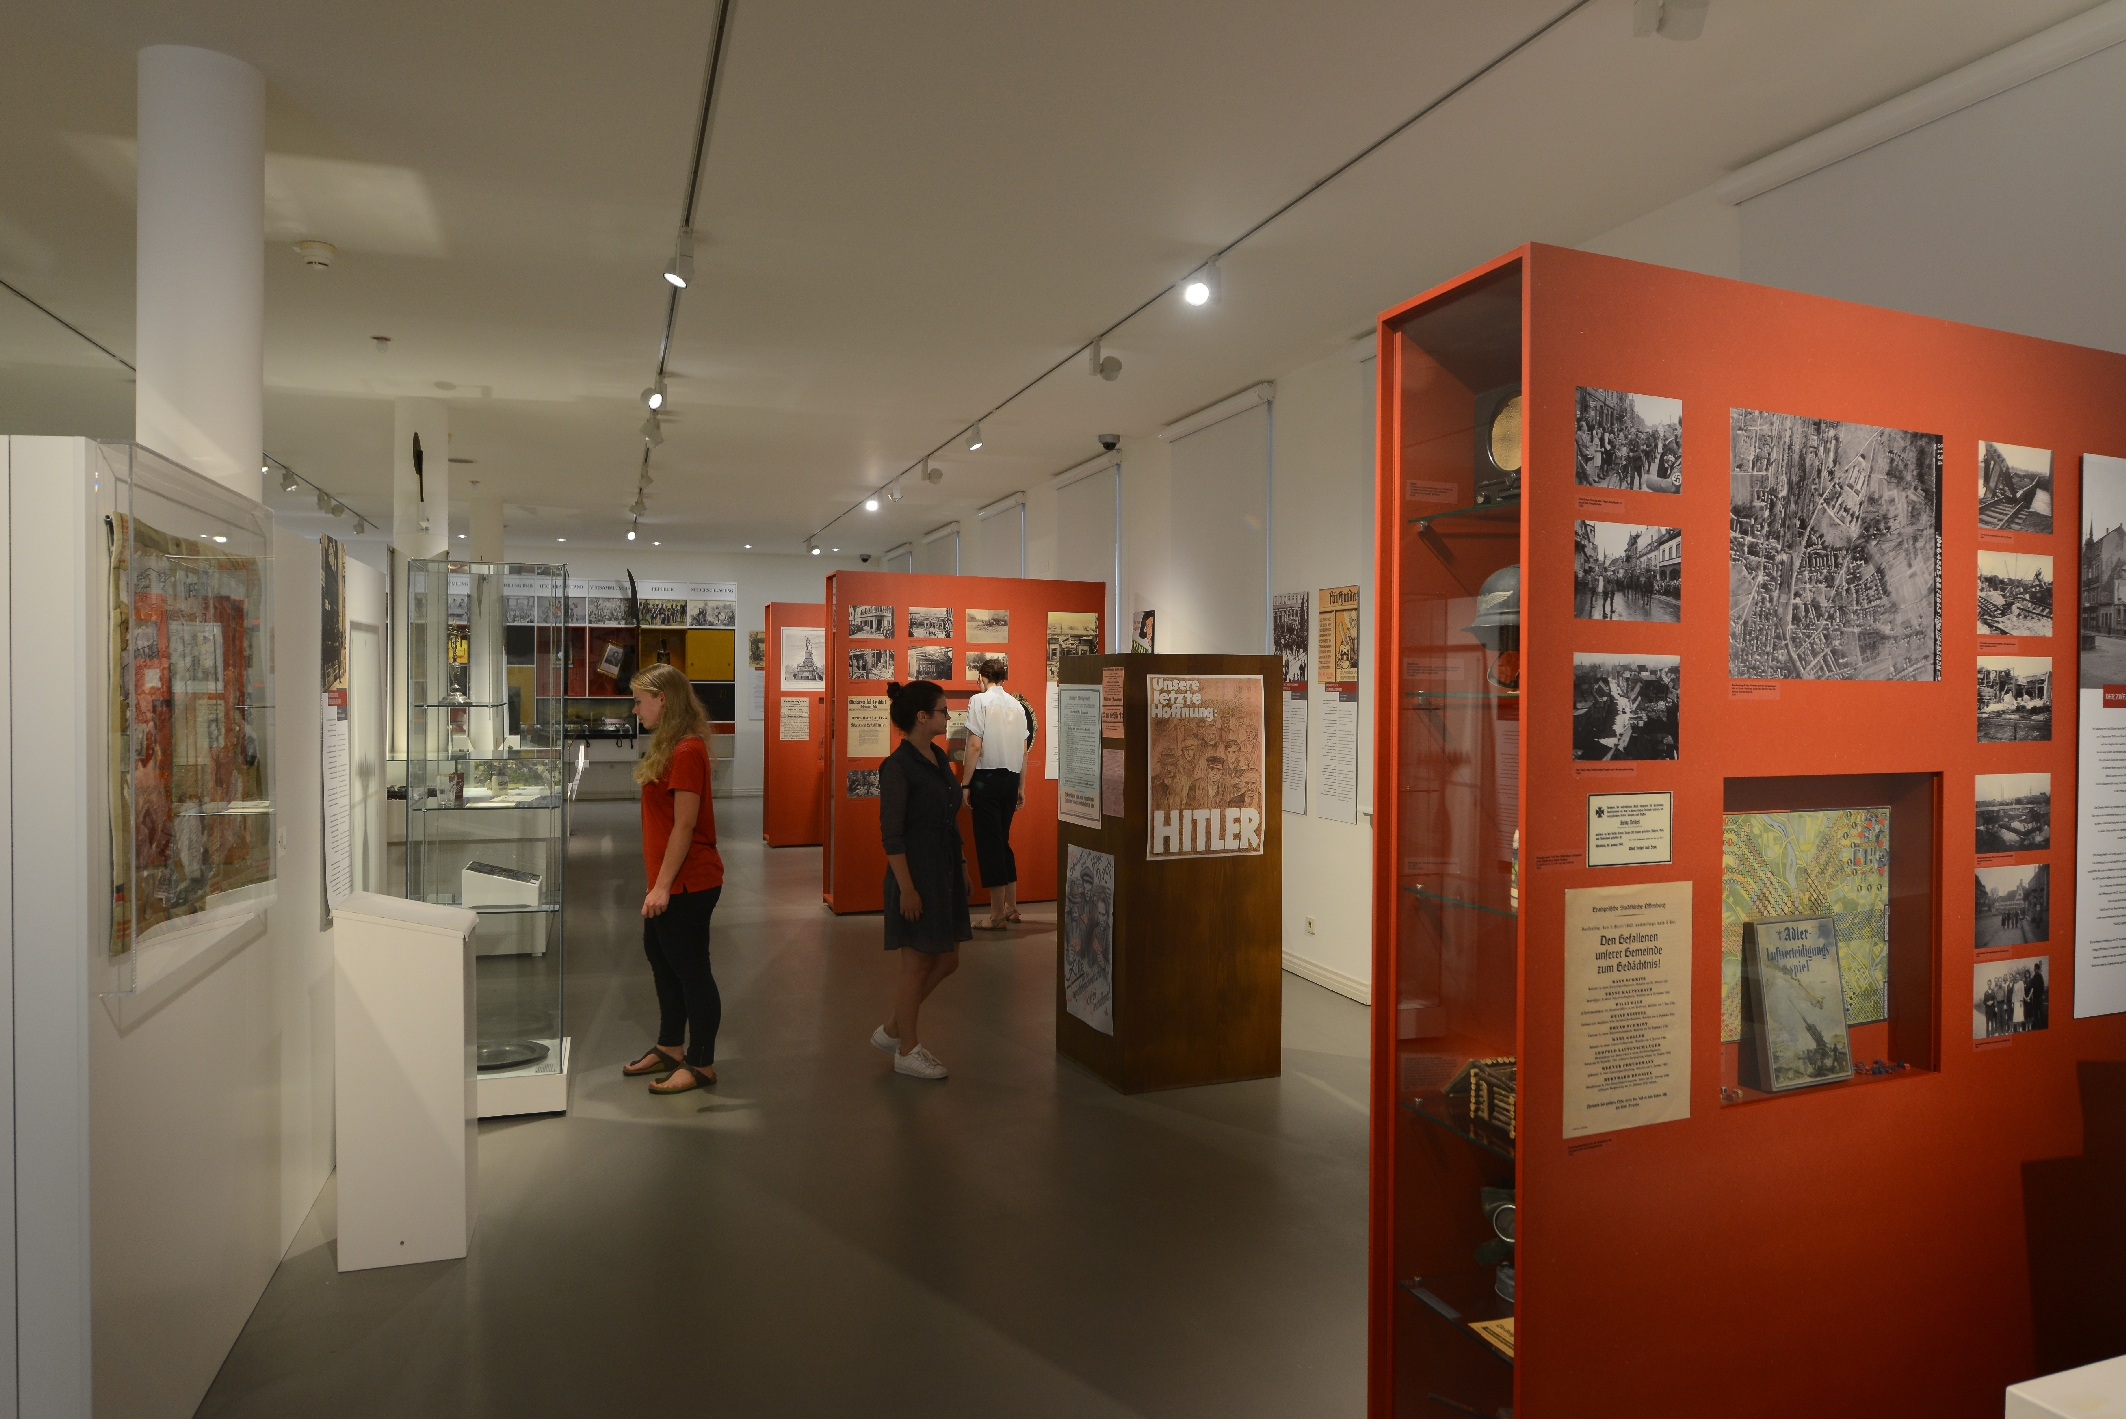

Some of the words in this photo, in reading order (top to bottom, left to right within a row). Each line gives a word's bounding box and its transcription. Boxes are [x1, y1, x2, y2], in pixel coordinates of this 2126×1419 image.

[1152, 677, 1200, 691] Unsere
[1153, 690, 1202, 705] letzte
[1151, 703, 1218, 722] Hoffnung:
[1153, 807, 1260, 854] HITLER
[1600, 934, 1616, 946] Den
[1618, 932, 1659, 946] Gefallenen
[1783, 926, 1812, 941] Adler-
[1595, 948, 1623, 961] unserer
[1624, 944, 1663, 958] Gemeinde
[1597, 964, 1614, 974] zum
[1616, 958, 1661, 973] Gedächtnis!
